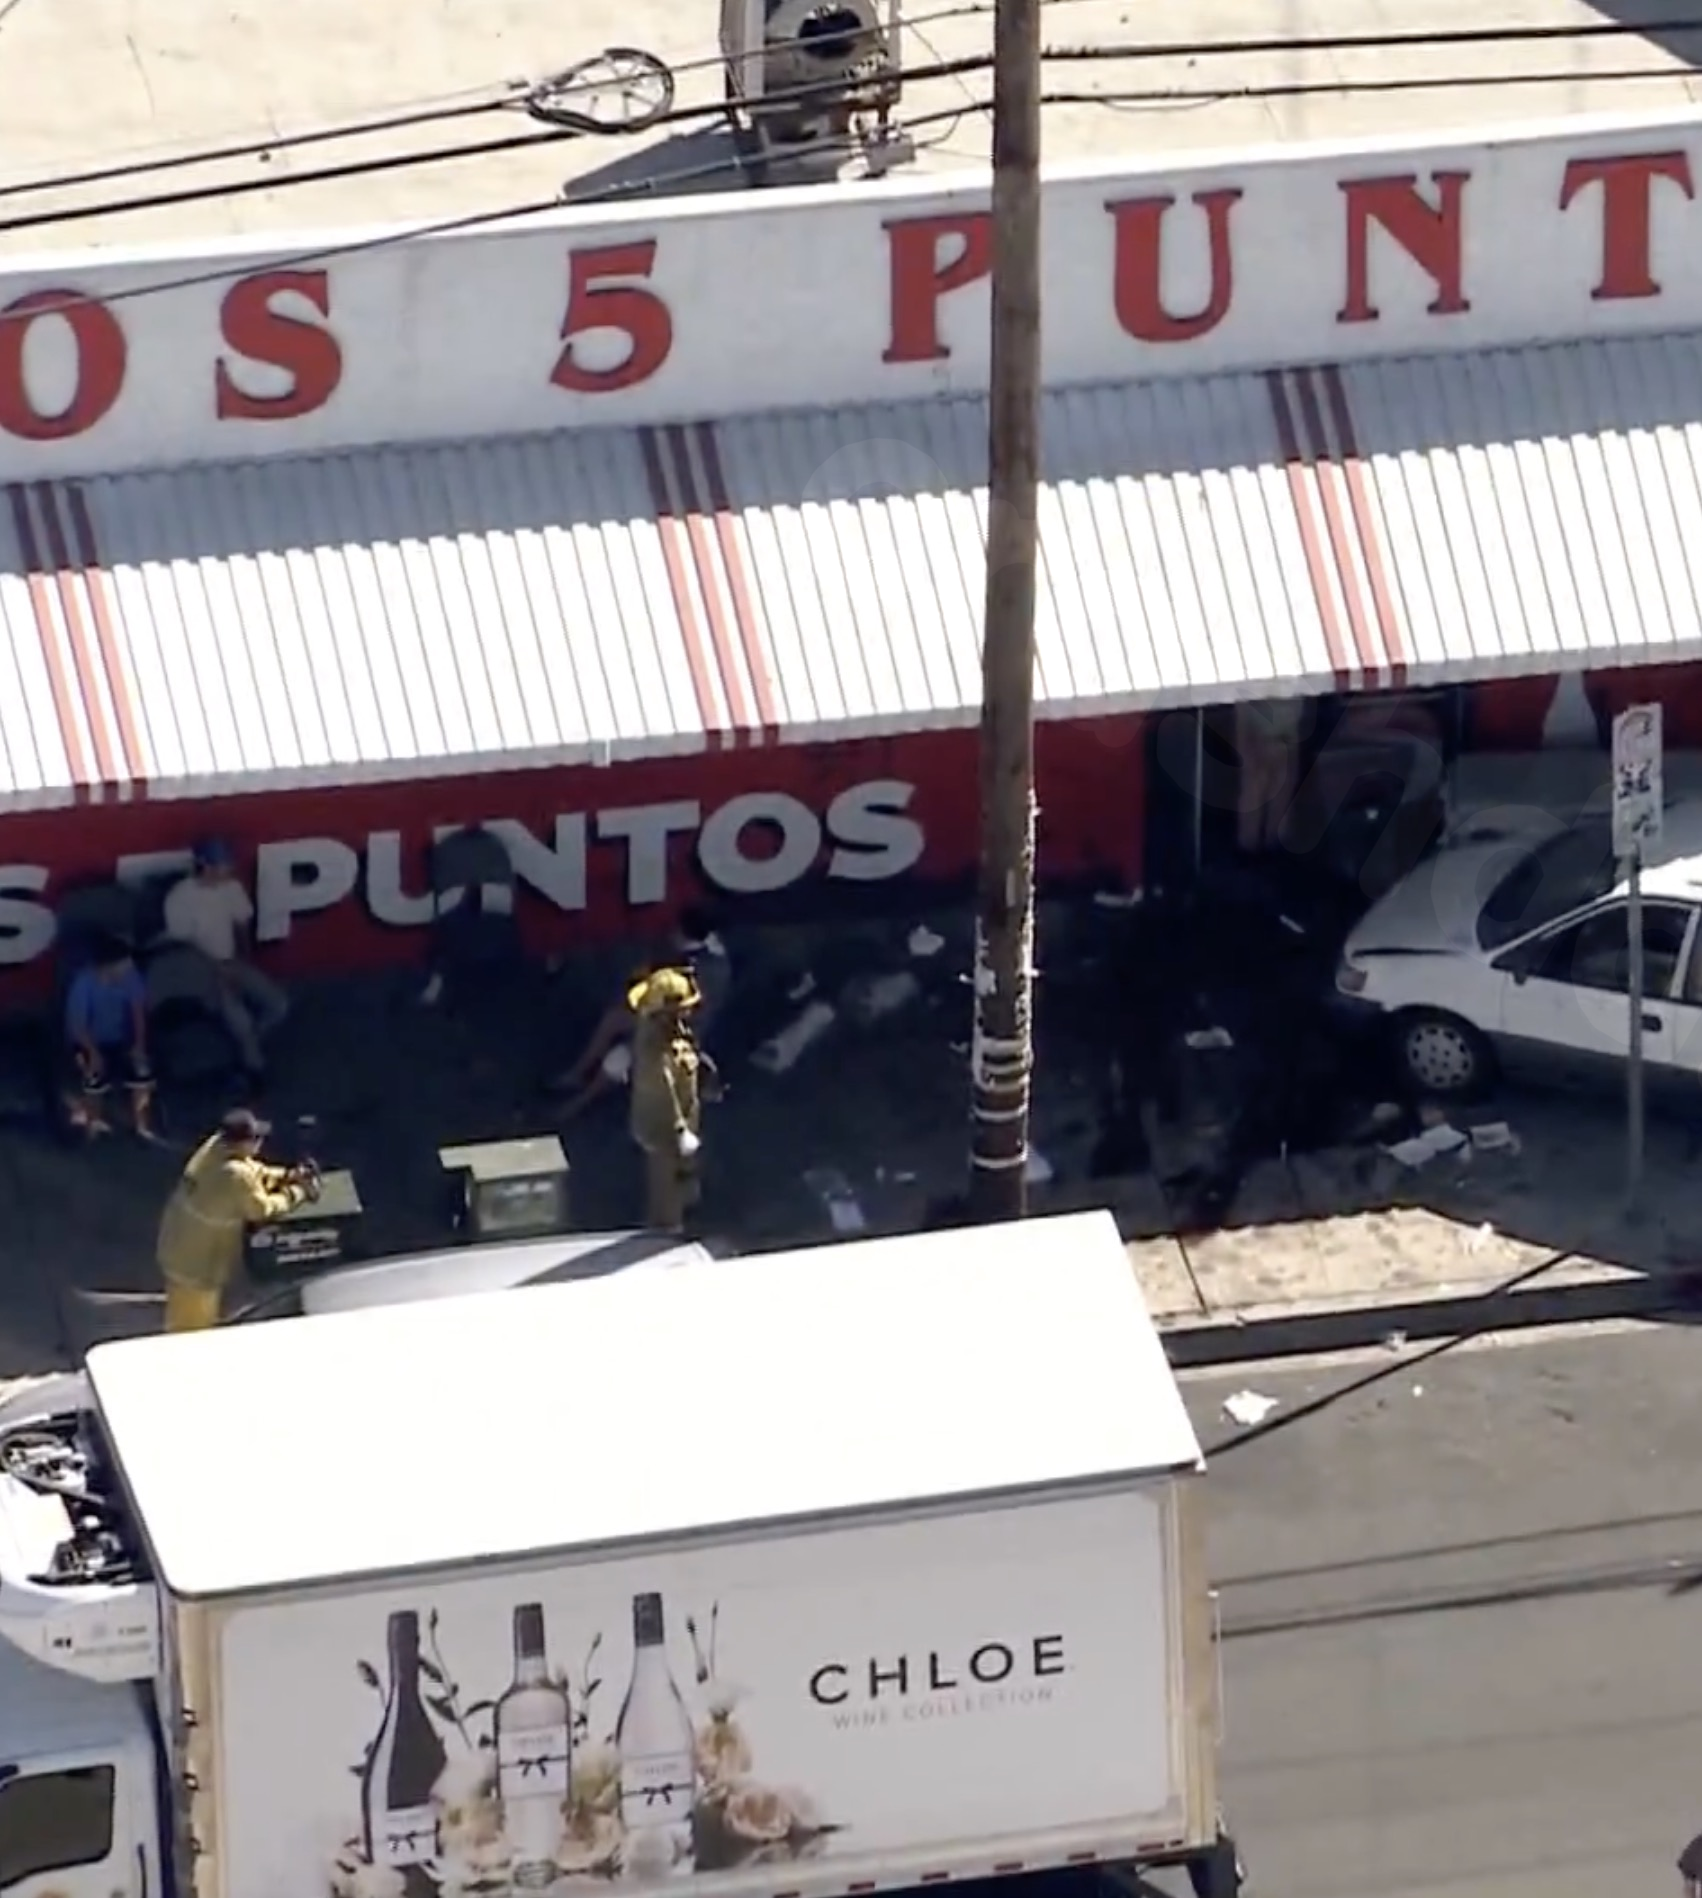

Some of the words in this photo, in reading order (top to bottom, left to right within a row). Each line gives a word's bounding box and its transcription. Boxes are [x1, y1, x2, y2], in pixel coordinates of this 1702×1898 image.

[550, 239, 674, 393] 5
[257, 779, 925, 942] PUNTOS
[809, 1634, 1066, 1705] CHLOE
[833, 1707, 888, 1730] WINE
[902, 1687, 1053, 1721] COLLECTION
